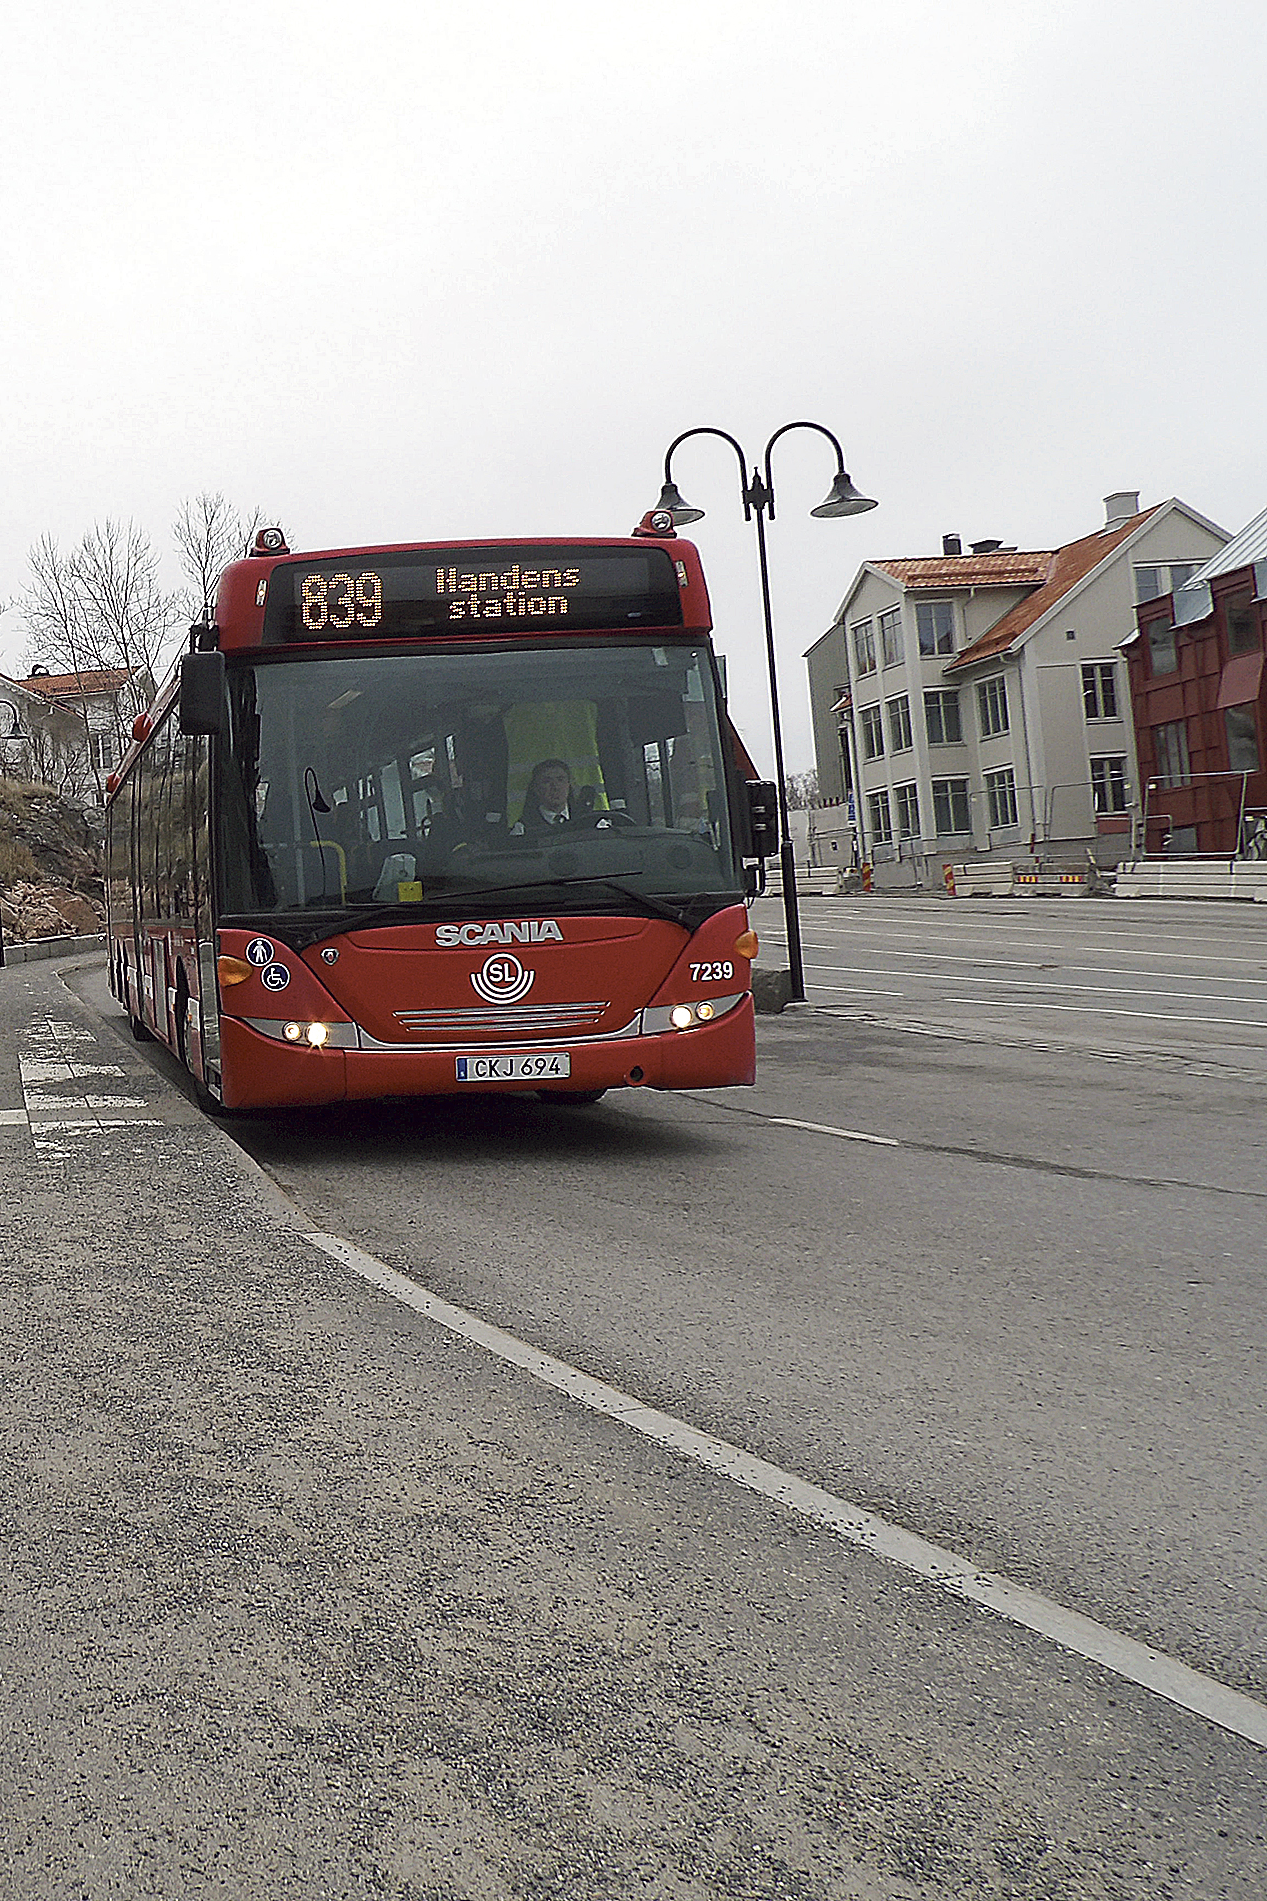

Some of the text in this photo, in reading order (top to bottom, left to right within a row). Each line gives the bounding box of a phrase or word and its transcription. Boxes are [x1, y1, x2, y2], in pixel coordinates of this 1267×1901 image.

[301, 572, 383, 630] 839
[449, 591, 569, 620] station
[435, 920, 564, 948] SCANIA
[489, 962, 516, 983] SL
[689, 961, 734, 981] 7239
[475, 1058, 514, 1078] CKJ
[520, 1056, 561, 1076] 694
